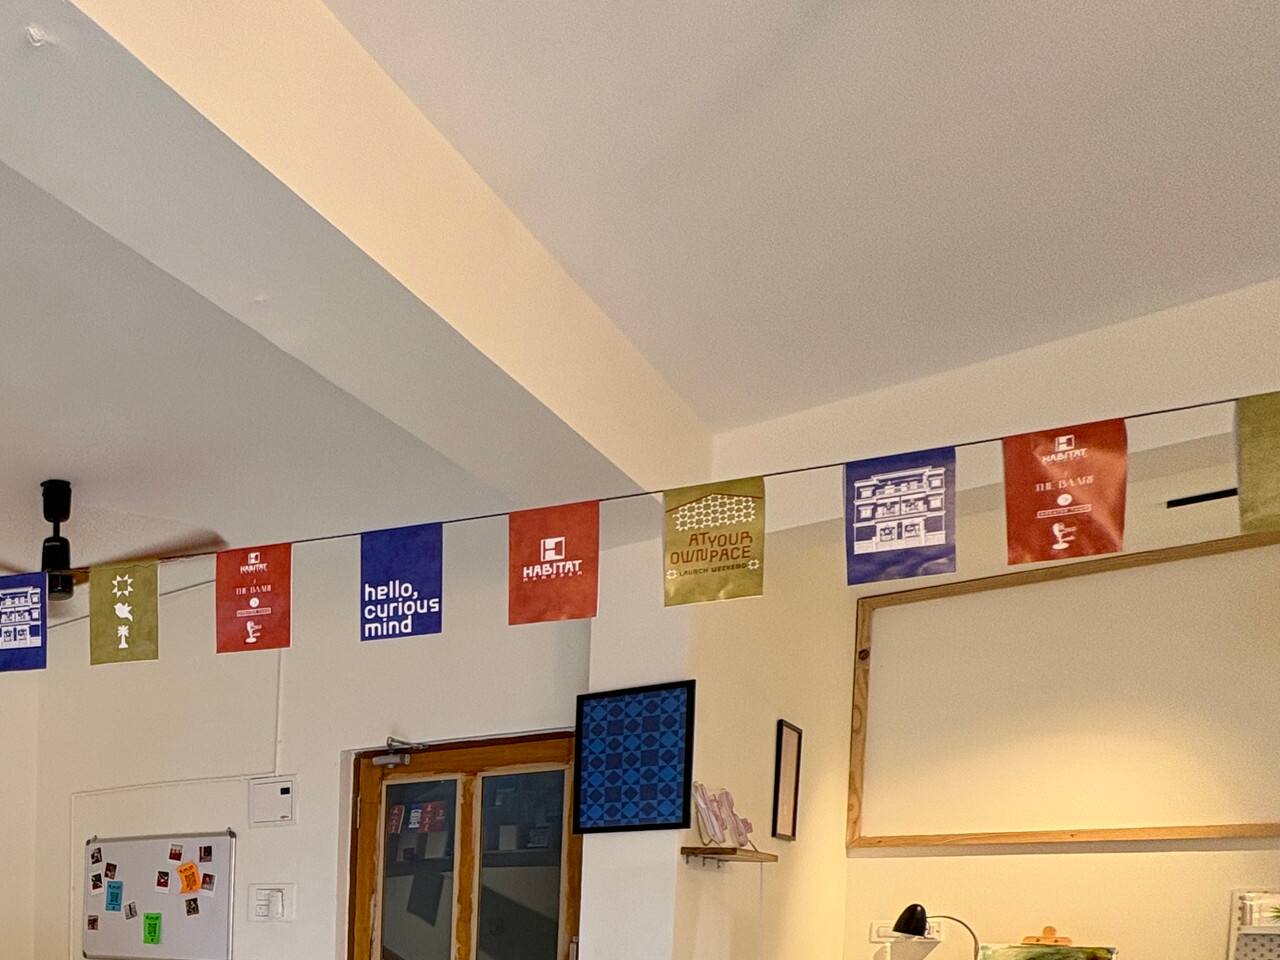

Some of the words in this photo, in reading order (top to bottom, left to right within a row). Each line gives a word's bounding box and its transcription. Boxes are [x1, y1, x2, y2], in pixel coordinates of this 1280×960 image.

[1041, 448, 1088, 463] HABITAT
[523, 559, 583, 578] HABITAT
[364, 580, 419, 601] hello,
[364, 598, 440, 619] curious
[364, 615, 413, 637] mind
